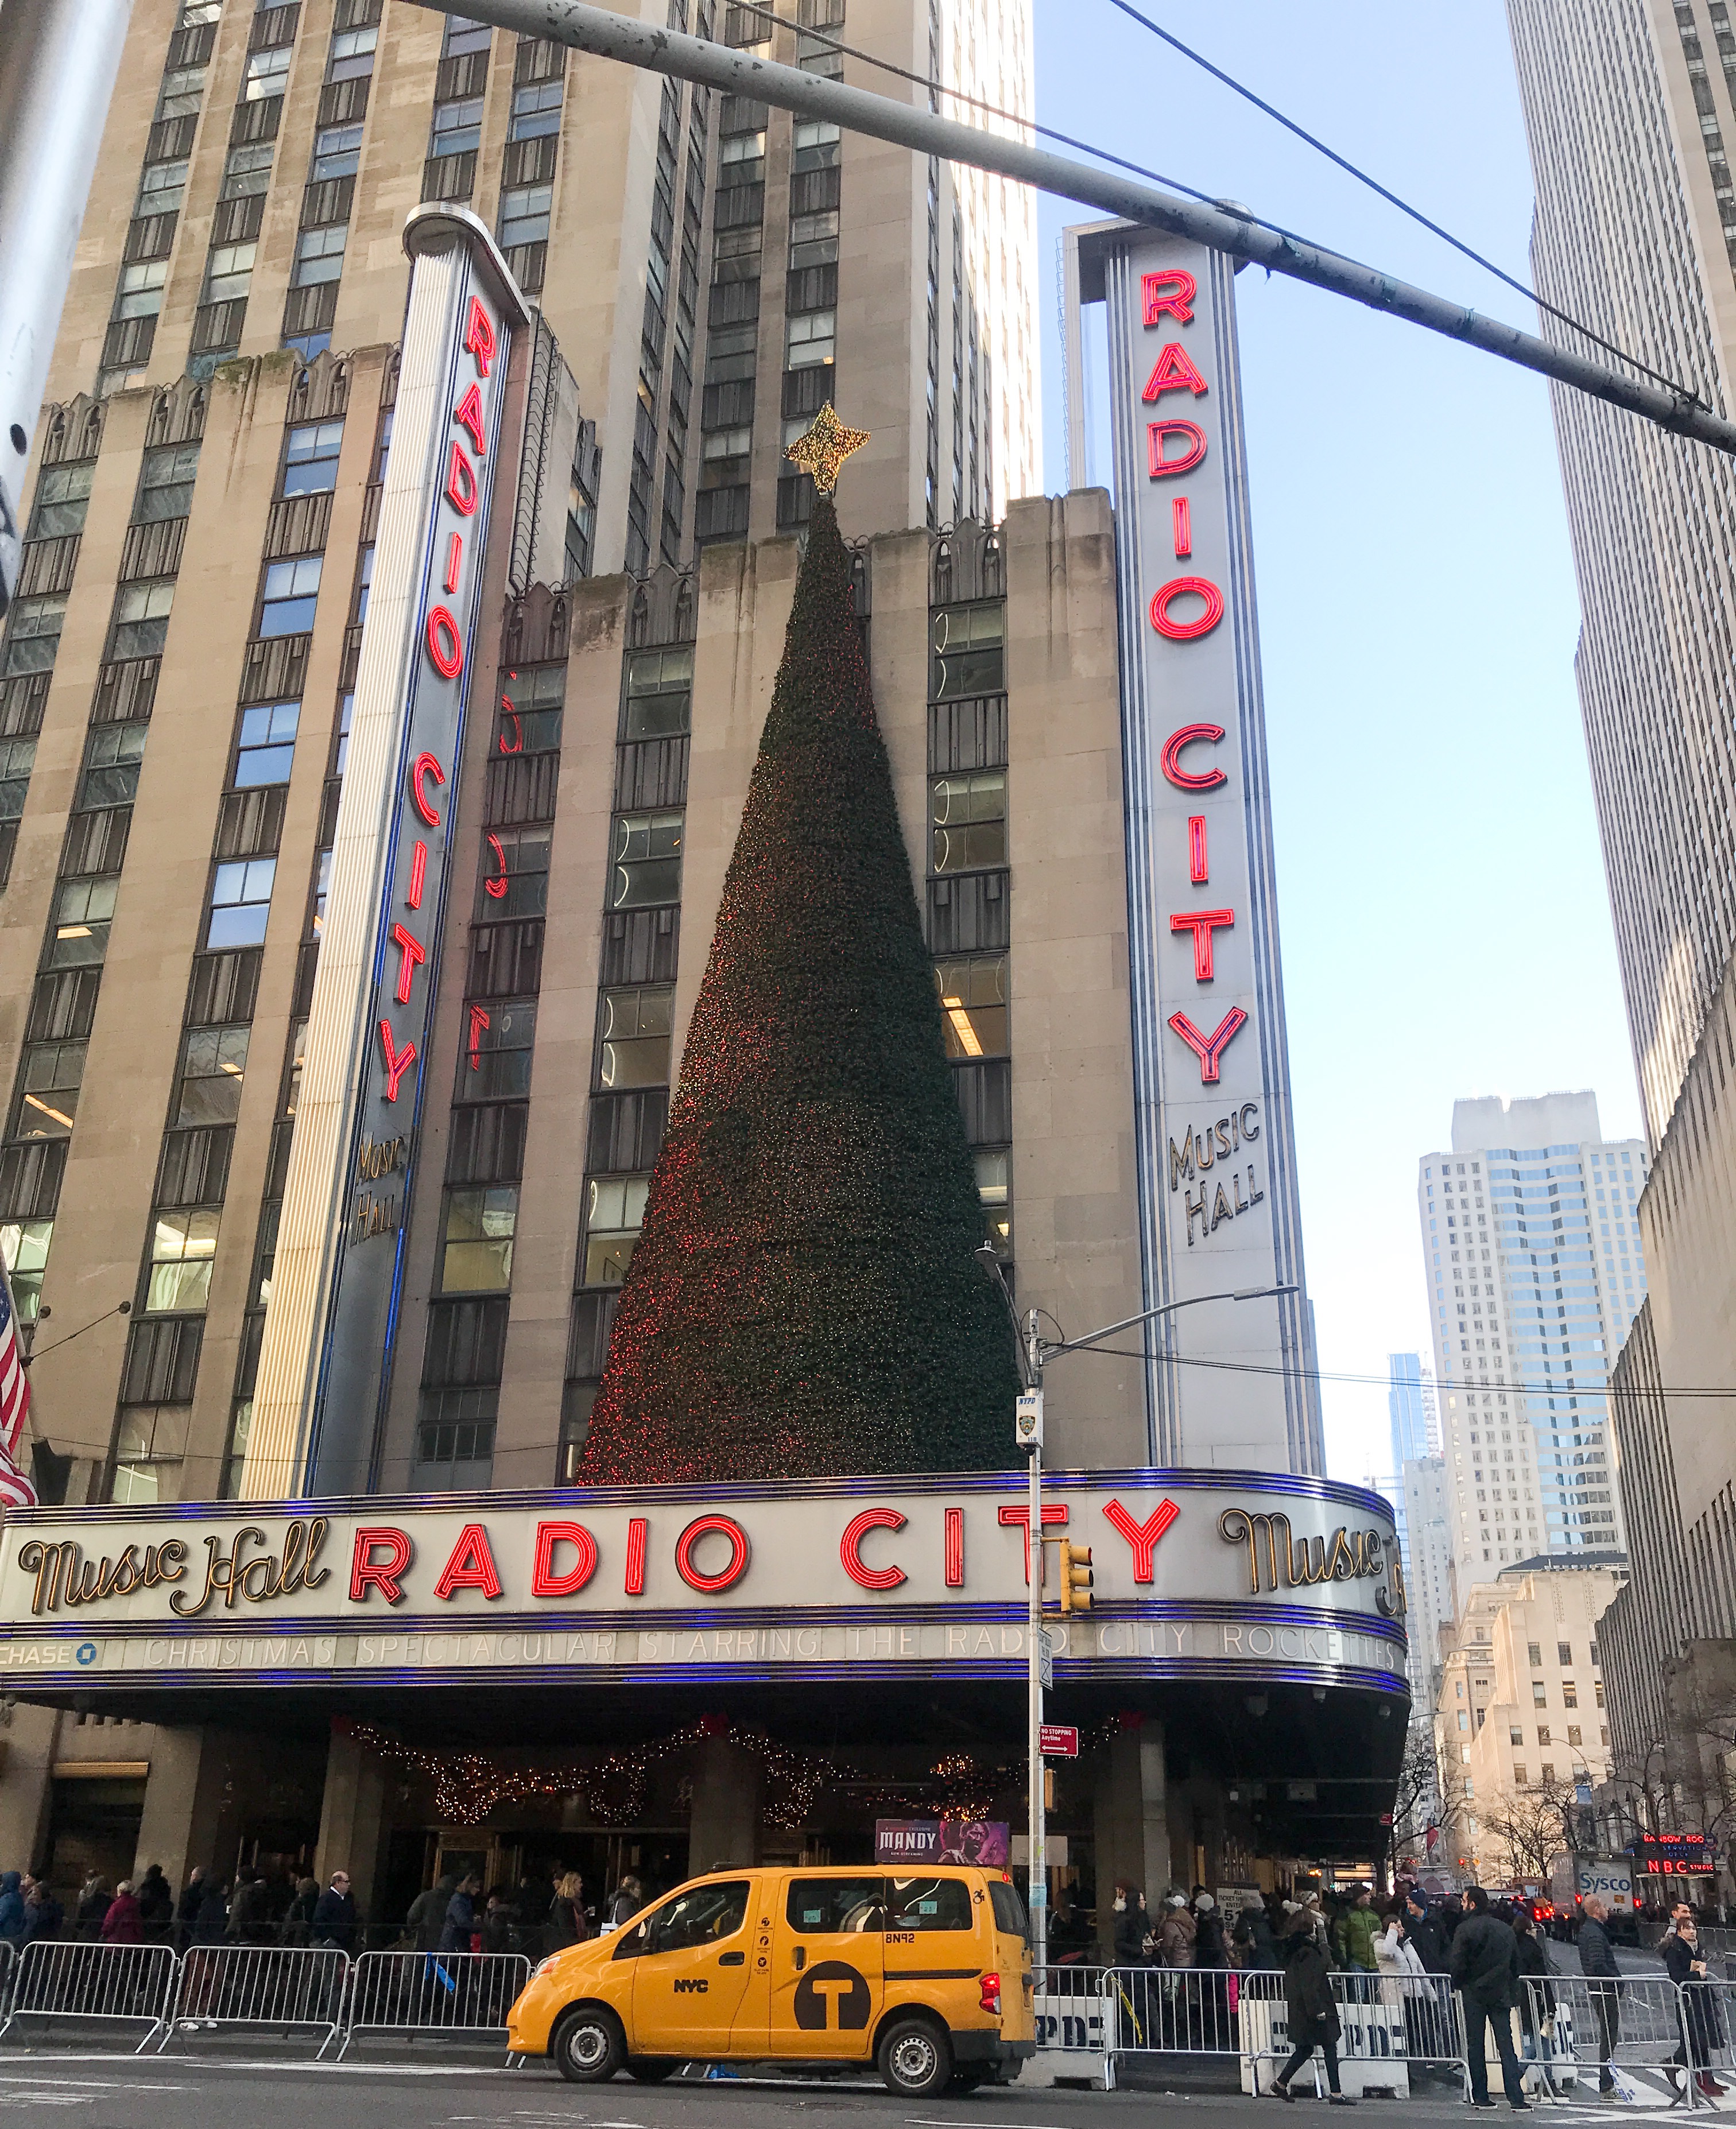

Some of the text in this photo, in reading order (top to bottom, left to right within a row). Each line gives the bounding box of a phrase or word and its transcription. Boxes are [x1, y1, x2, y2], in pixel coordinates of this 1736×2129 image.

[378, 294, 497, 1103] RADIO CITY
[1141, 269, 1248, 1085] RADIO CITY
[1170, 1103, 1259, 1192] MUSIC
[1185, 1164, 1264, 1246] HALL
[18, 1517, 331, 1616] Music Hall
[348, 1498, 1180, 1606] RADIO CITY
[1218, 1507, 1384, 1594] Music
[0, 1645, 73, 1665] CHASE
[148, 1636, 333, 1665] CHRISTMAS
[360, 1632, 613, 1664] SPECTACULAR
[641, 1628, 817, 1659] STARRING
[850, 1627, 916, 1655] THE
[948, 1625, 1068, 1654] RADO
[1100, 1623, 1189, 1653] CITY
[1223, 1624, 1394, 1670] ROCKETTES
[879, 1832, 936, 1851] MANDY
[1643, 1835, 1681, 1843] RANBOW
[1580, 1872, 1631, 1894] Sysco
[1648, 1860, 1687, 1873] NBC
[886, 1933, 914, 1943] 8N92
[674, 1979, 708, 1992] NYC
